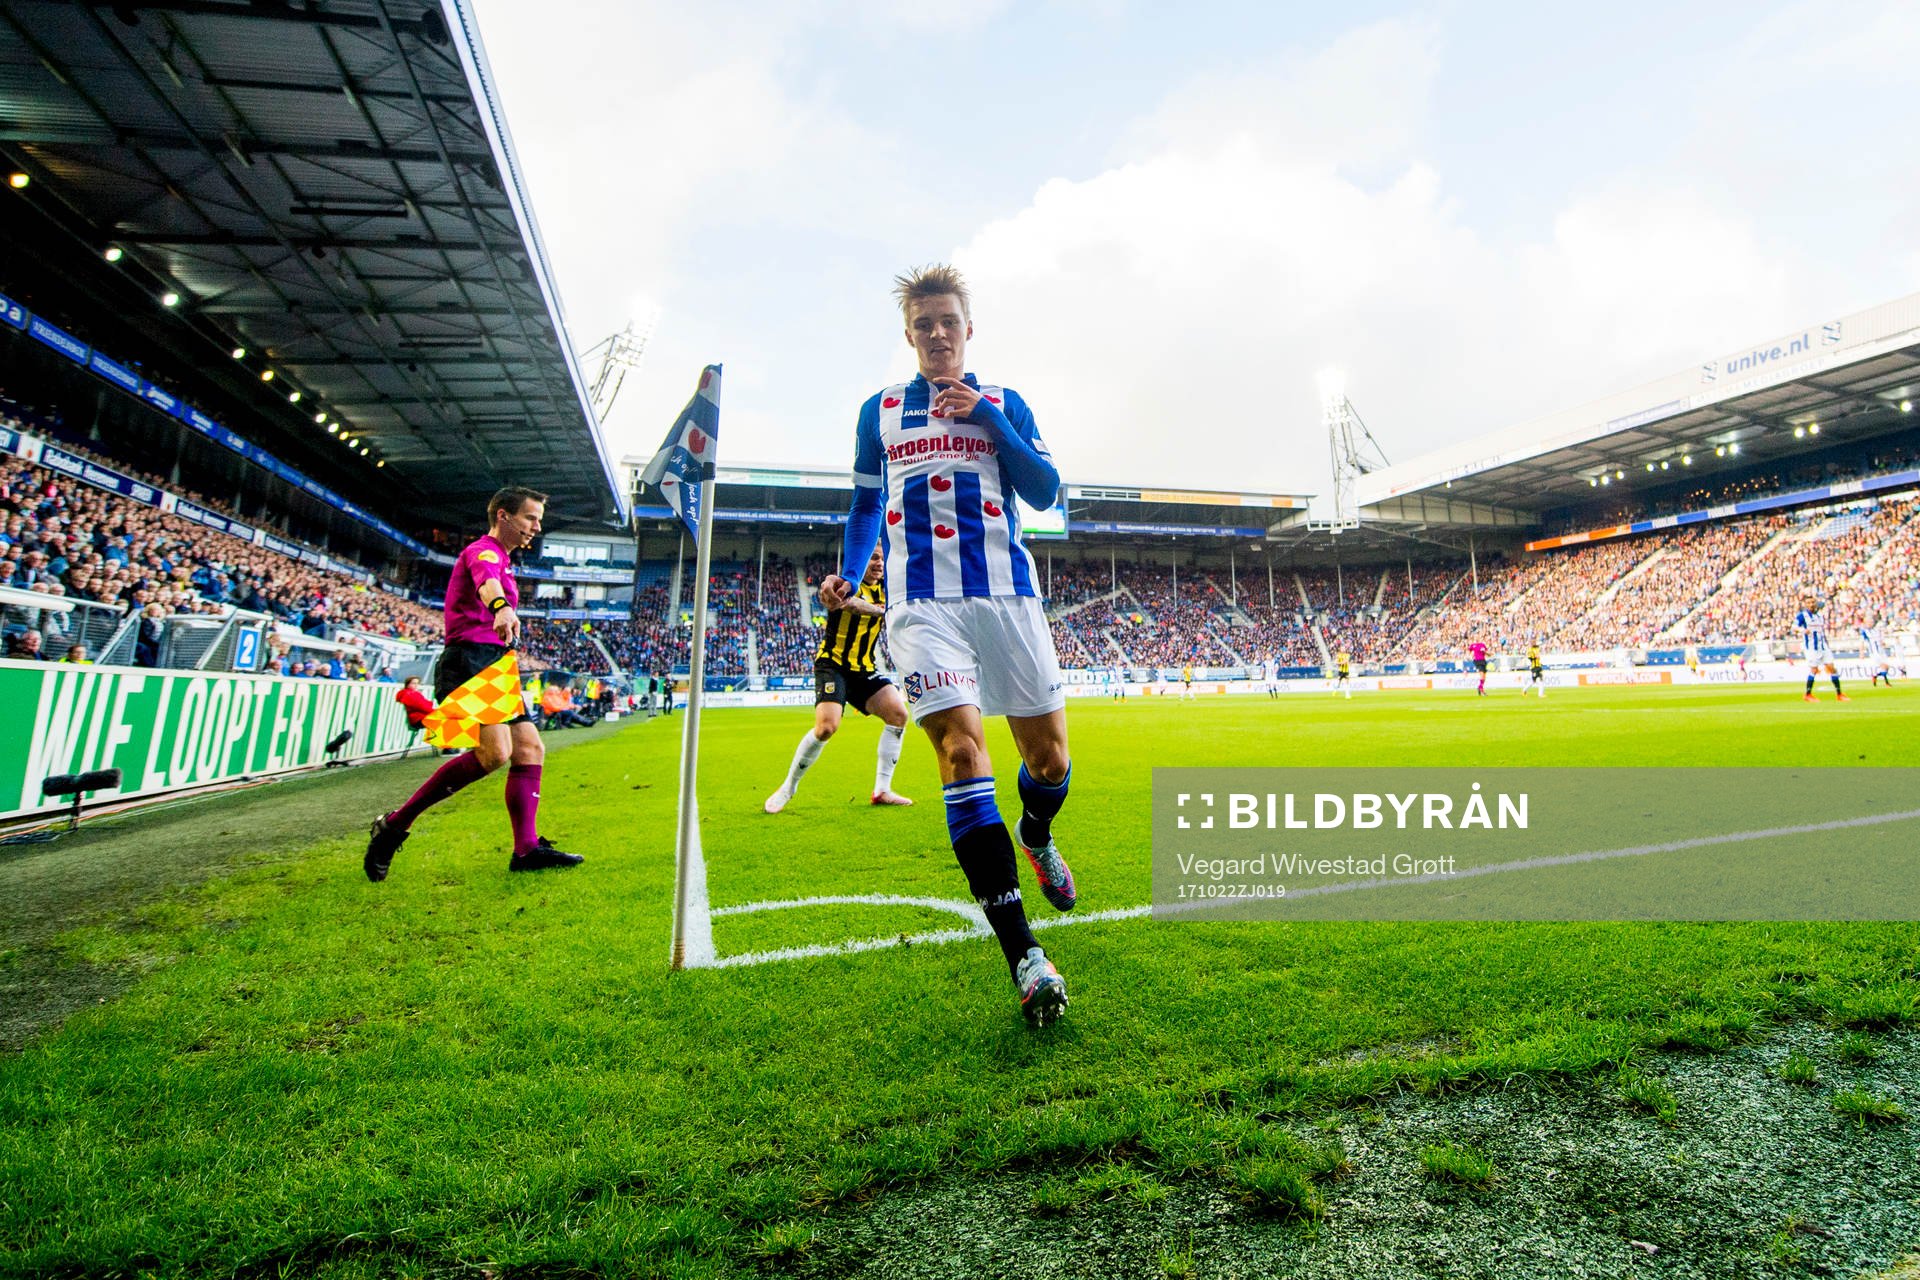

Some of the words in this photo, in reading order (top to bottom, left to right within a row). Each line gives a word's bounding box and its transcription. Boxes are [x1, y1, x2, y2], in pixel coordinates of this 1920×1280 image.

[1727, 333, 1809, 374] unive.nl
[903, 408, 928, 417] JAKO
[240, 634, 255, 664] 2
[19, 670, 146, 810] WIE
[140, 676, 273, 791] LOOPT
[266, 683, 311, 771] ER
[309, 684, 378, 763] WARM
